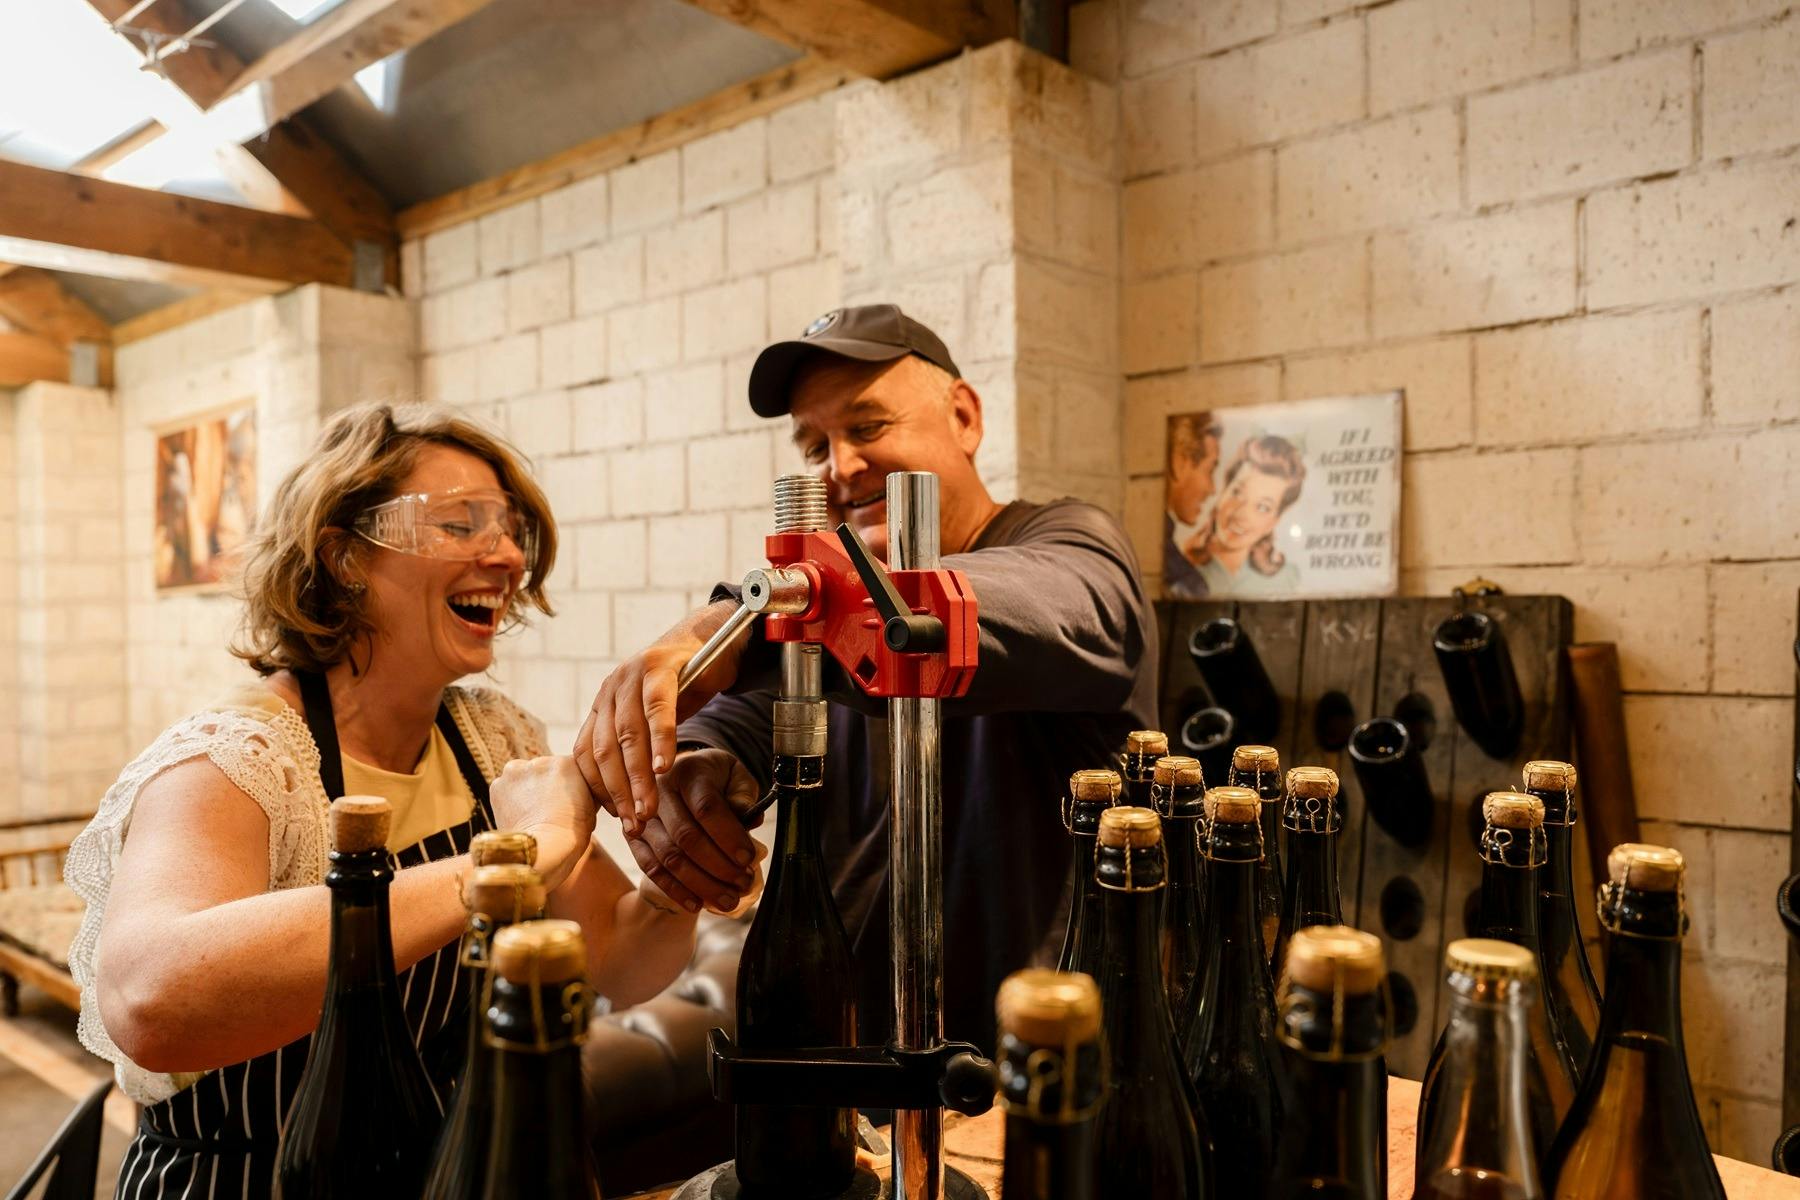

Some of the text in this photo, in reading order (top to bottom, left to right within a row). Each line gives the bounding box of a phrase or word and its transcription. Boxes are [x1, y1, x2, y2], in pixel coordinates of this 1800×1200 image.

[1314, 447, 1396, 467] AGREED
[1327, 467, 1380, 486] WITH
[1305, 530, 1386, 550] BOTH BE
[1310, 551, 1382, 570] WRONG
